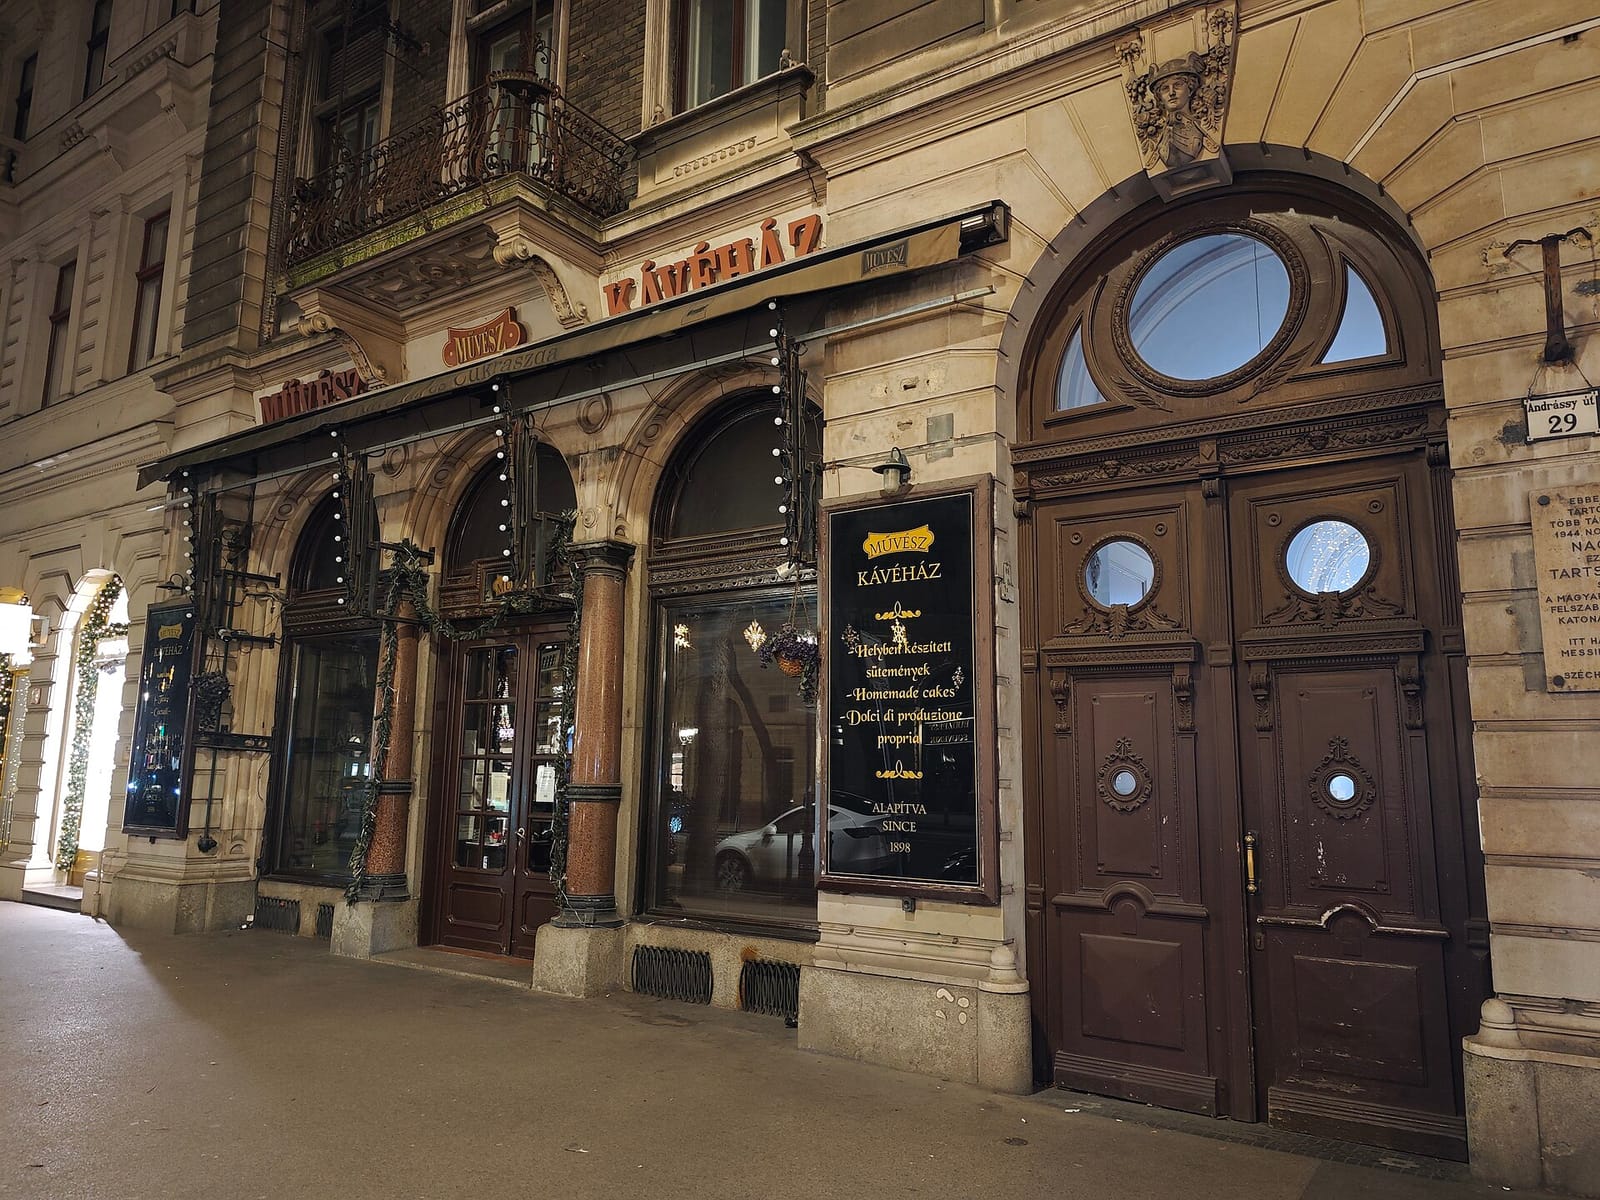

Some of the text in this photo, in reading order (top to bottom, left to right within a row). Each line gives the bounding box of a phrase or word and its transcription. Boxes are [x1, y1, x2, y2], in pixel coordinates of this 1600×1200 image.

[603, 214, 823, 317] KÁVÉHÁZ
[454, 321, 507, 363] MŰVÉSZ
[1528, 395, 1595, 413] Andrássy út
[1548, 413, 1577, 434] 29
[1550, 518, 1580, 528] TÖBB
[869, 533, 928, 557] MŰVÉSZ
[857, 560, 942, 587] KÁVÉHÁZ
[904, 640, 951, 654] készített
[1569, 638, 1585, 646] ITT
[866, 662, 931, 681] sütemények
[845, 684, 955, 701] -Homemade cakes
[840, 707, 963, 726] -Dolci di produzione
[877, 731, 921, 749] propria
[872, 800, 927, 815] ALAPÍTVA
[882, 820, 917, 832] SINCE
[890, 841, 911, 853] 1898
